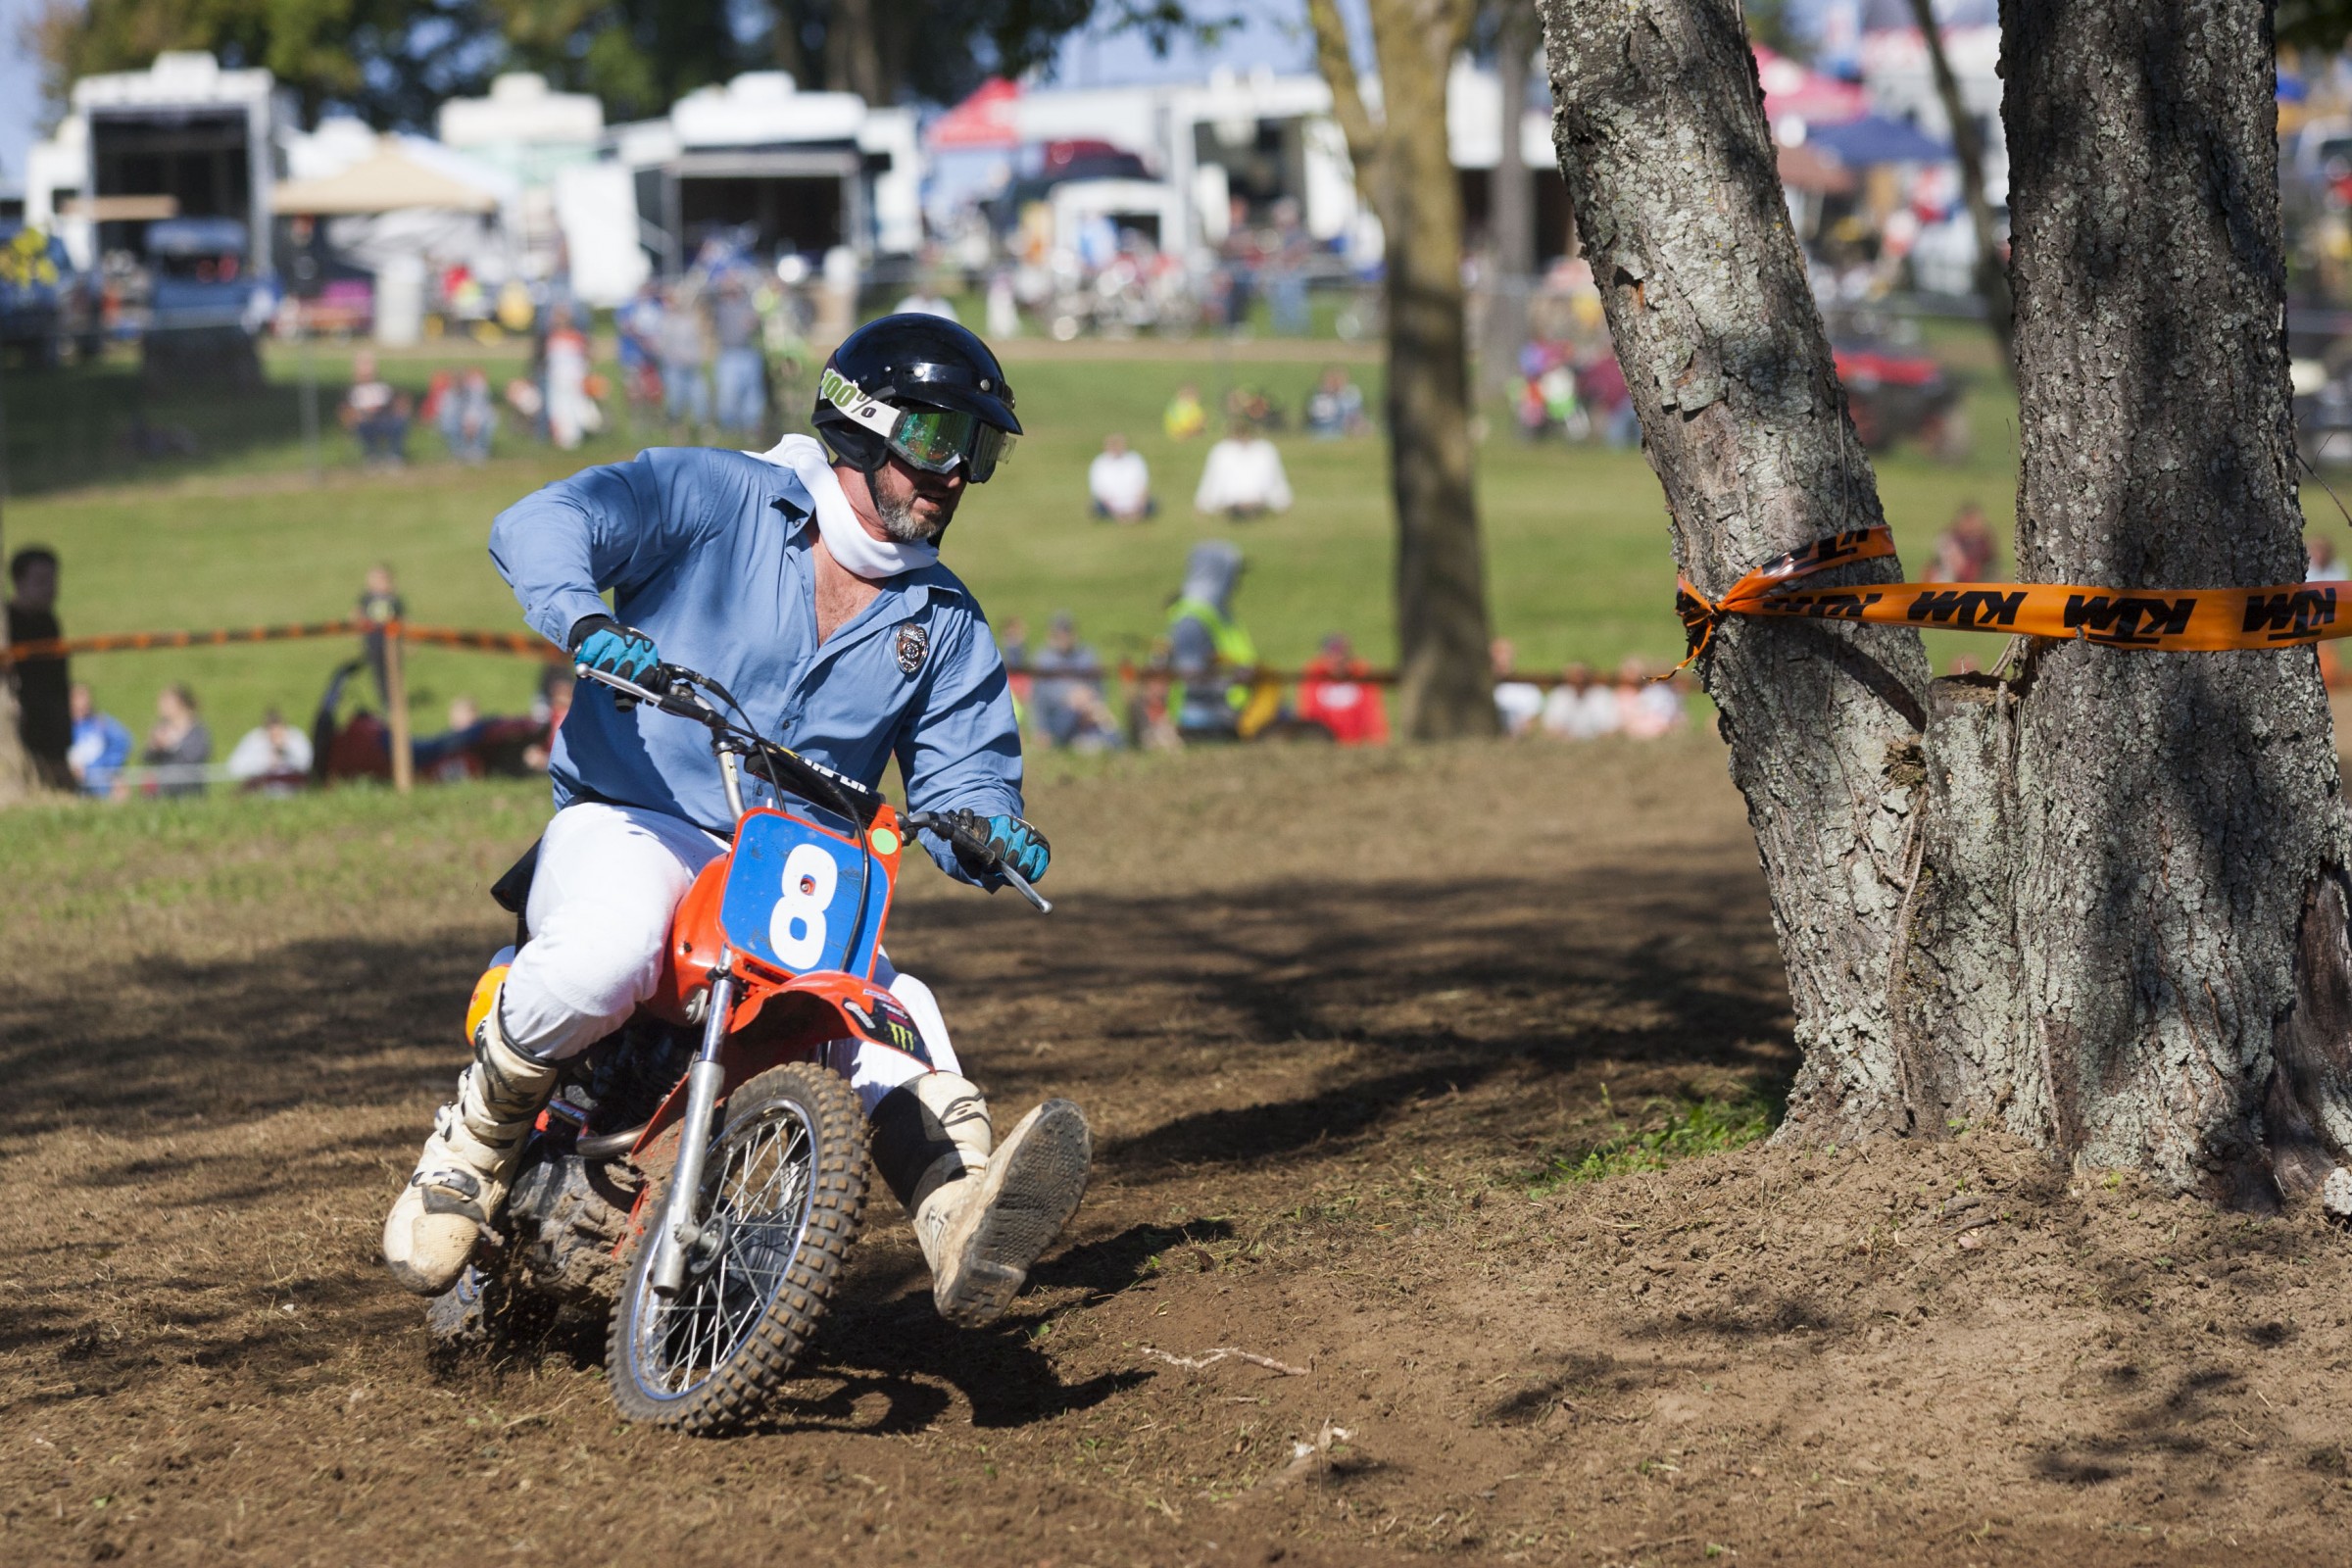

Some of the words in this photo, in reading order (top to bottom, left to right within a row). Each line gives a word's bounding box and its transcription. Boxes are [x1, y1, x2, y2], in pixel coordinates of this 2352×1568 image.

[821, 370, 877, 418] 100%
[1907, 590, 2029, 632] KTM
[2063, 594, 2197, 644] KTM
[2241, 587, 2337, 641] KTM
[769, 843, 838, 970] 8
